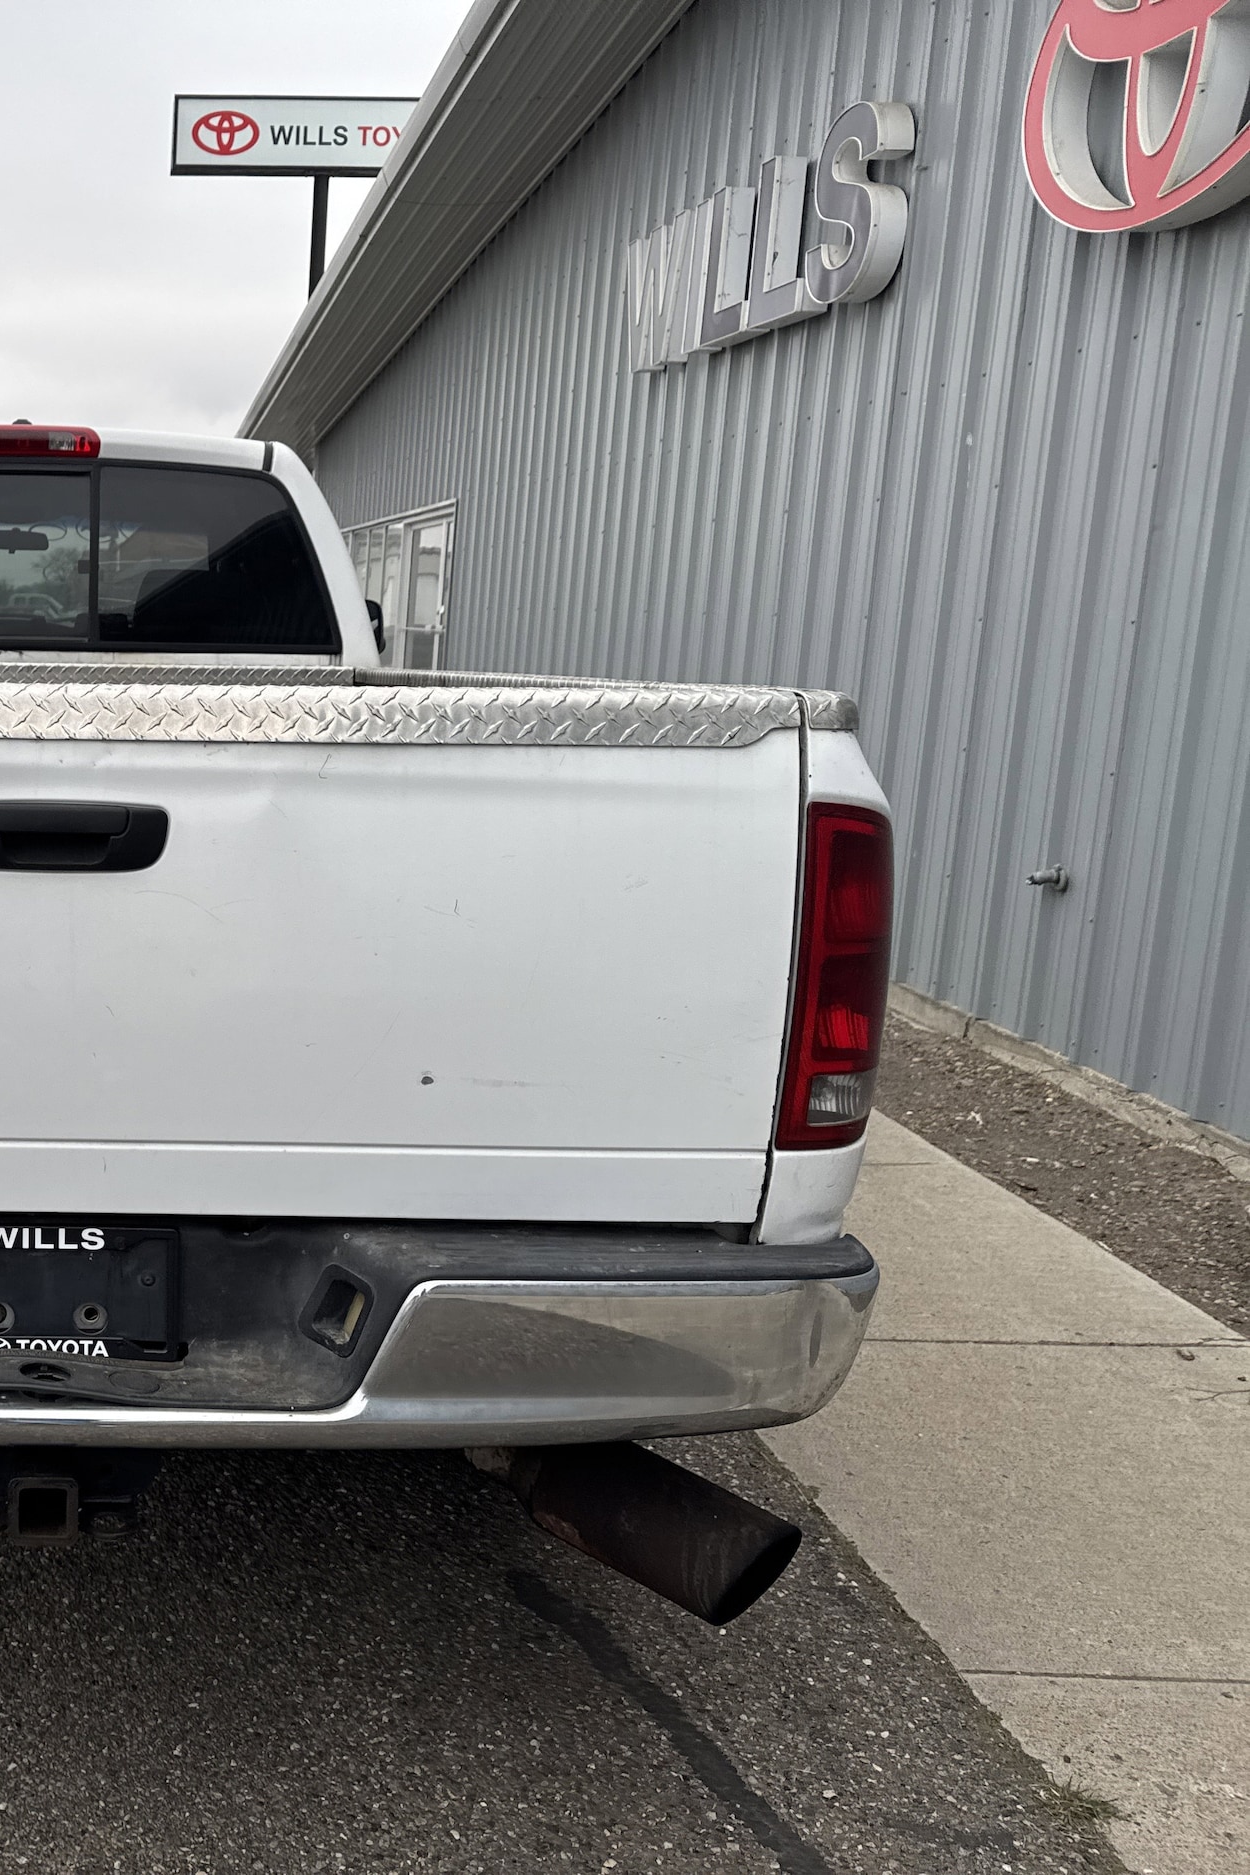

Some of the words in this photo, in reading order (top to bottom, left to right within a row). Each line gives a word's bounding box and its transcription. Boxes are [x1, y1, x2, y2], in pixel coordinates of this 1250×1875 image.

[270, 125, 349, 146] WILLS
[627, 101, 915, 373] WILLS
[15, 1339, 110, 1358] TOYOTA
